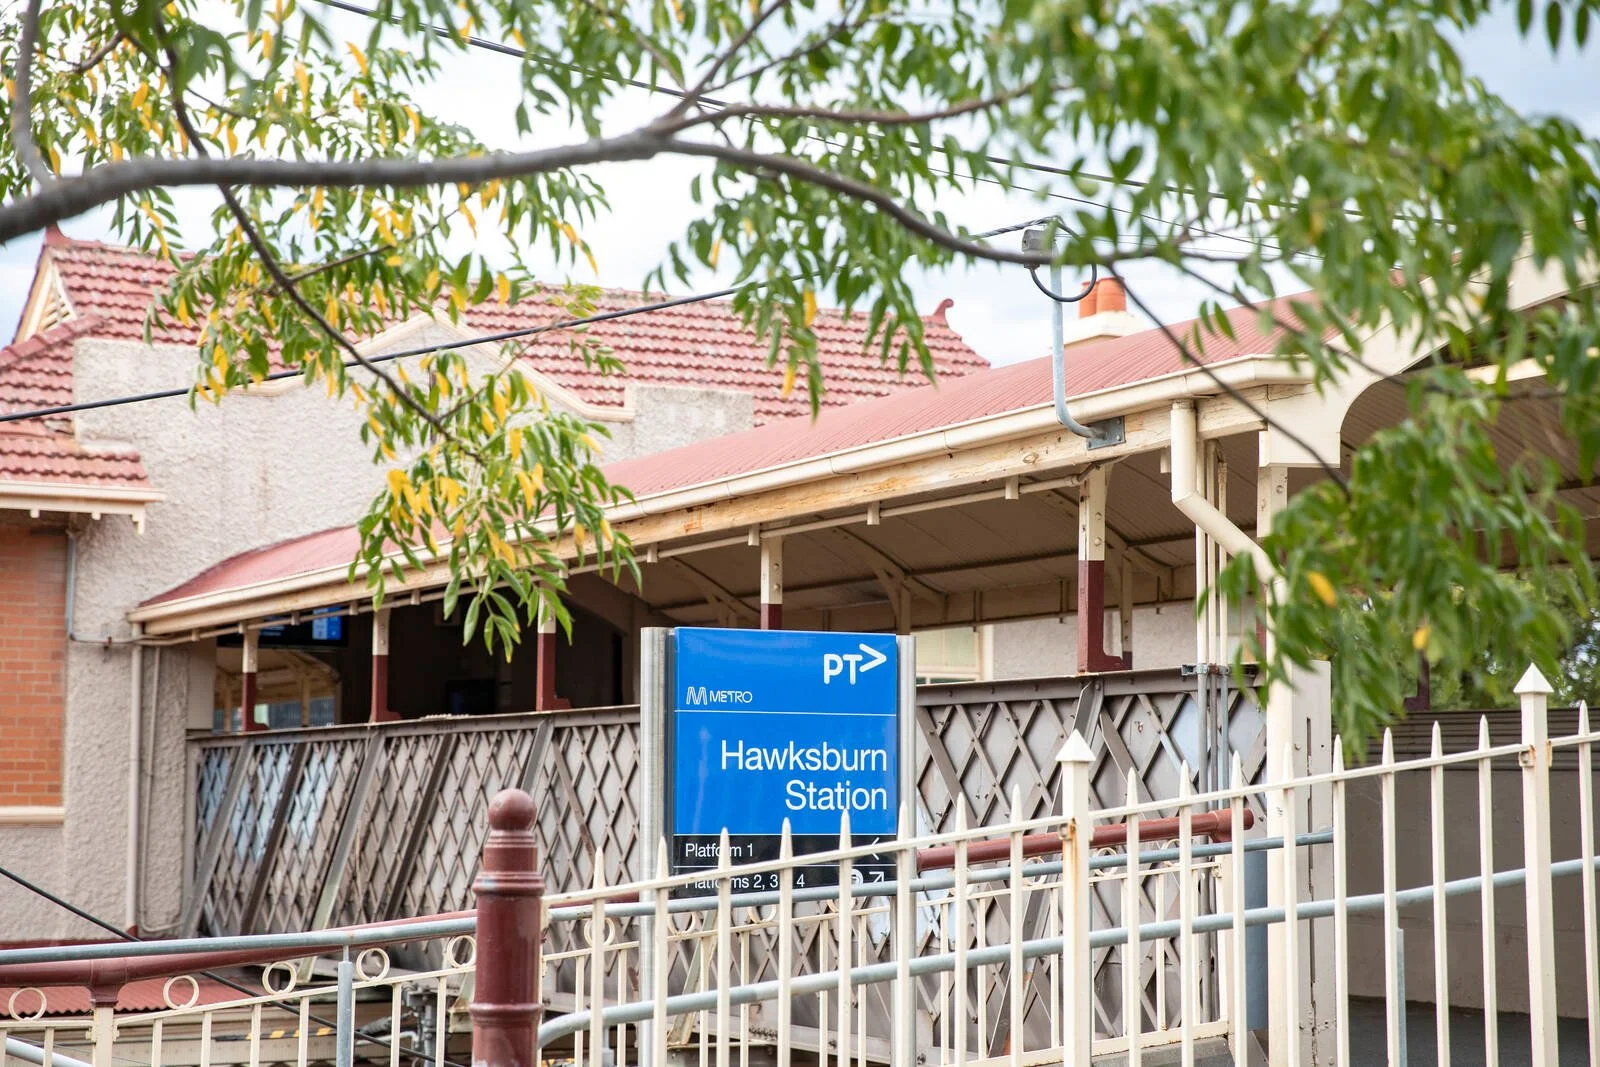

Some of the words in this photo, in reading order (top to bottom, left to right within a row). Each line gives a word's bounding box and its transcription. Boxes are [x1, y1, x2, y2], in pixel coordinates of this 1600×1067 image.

[709, 689, 753, 703] METRO
[721, 740, 888, 772] Hawksburn
[785, 780, 888, 811] Station
[685, 843, 742, 857] Platfom
[747, 843, 753, 857] 1
[753, 874, 766, 891] 2,
[769, 874, 779, 888] 3
[796, 873, 806, 888] 4
